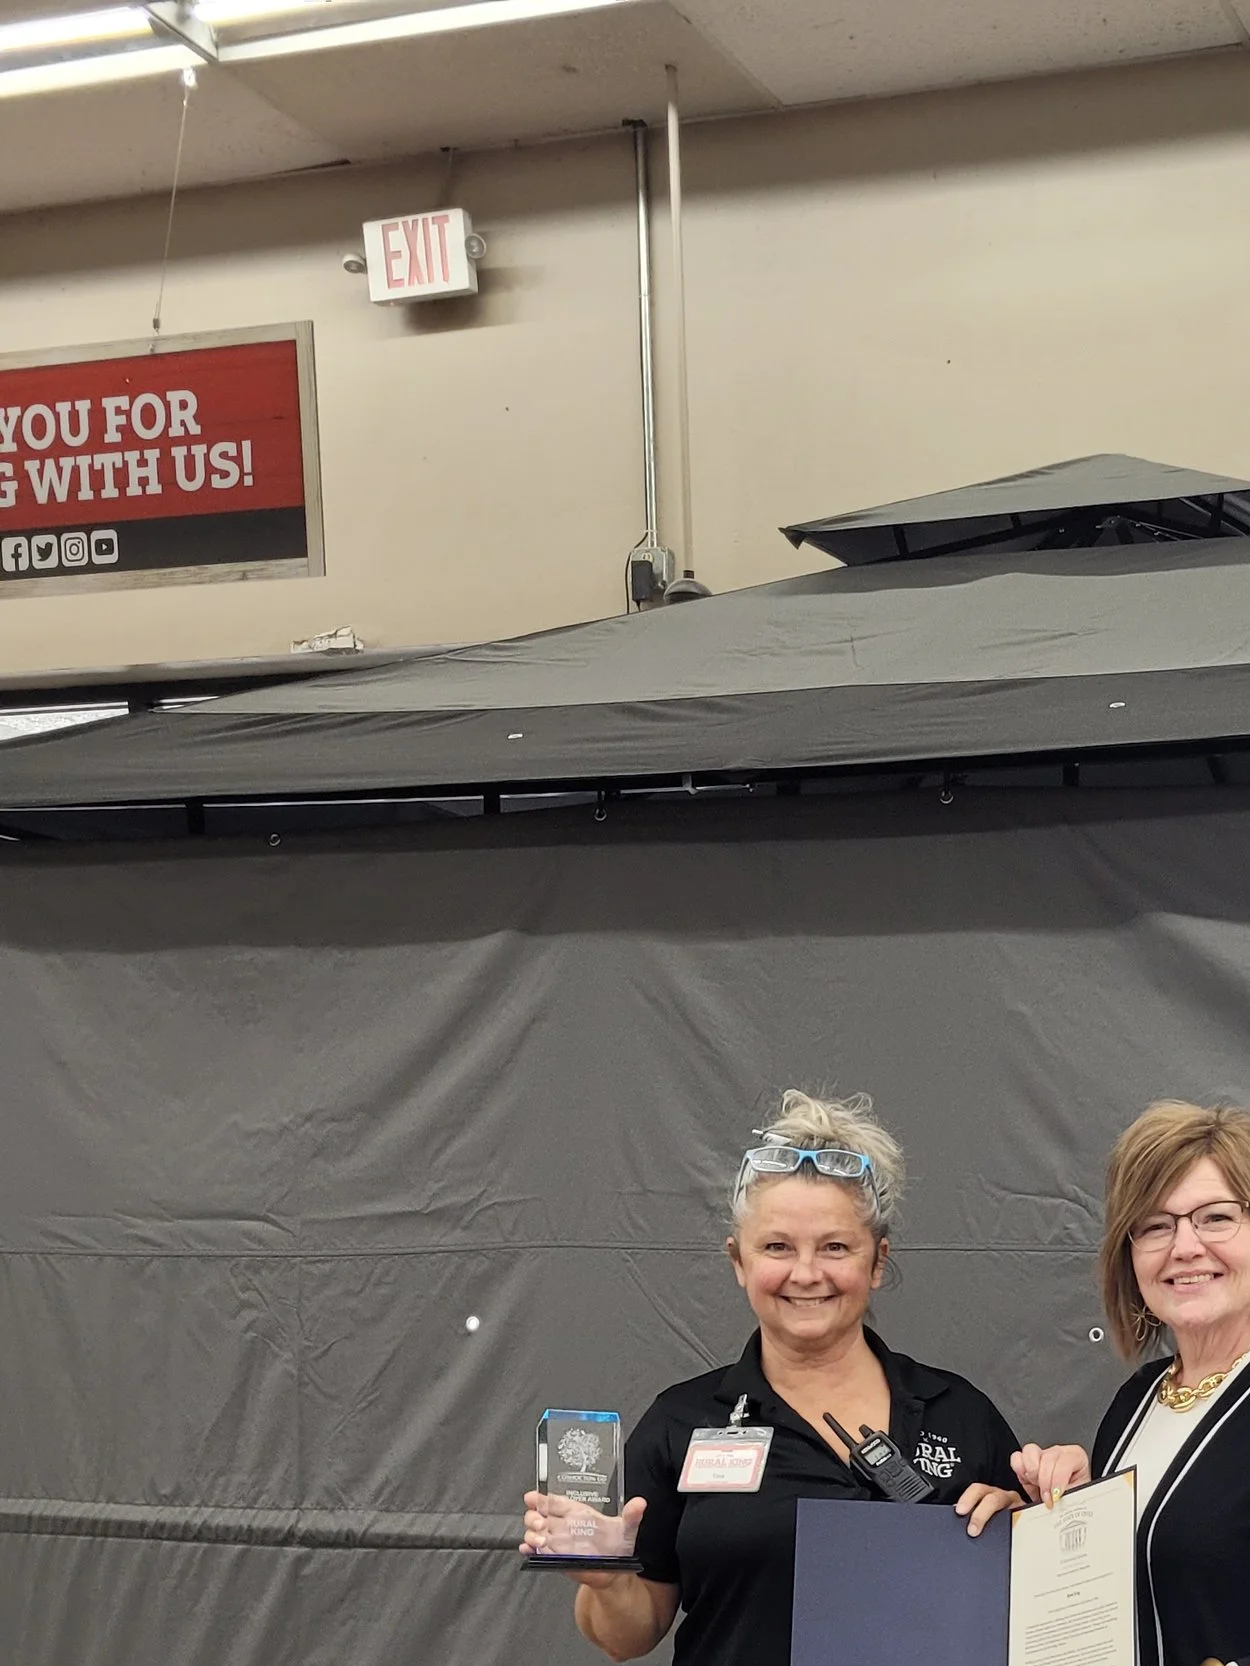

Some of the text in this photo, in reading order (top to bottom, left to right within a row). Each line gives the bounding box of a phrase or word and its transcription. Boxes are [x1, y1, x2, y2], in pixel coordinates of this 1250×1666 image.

[381, 214, 450, 289] EXIT
[0, 389, 201, 453] YOU FOR
[24, 448, 162, 504] WITH
[171, 440, 254, 492] US!
[915, 1443, 961, 1463] RAL
[566, 1519, 598, 1529] RURAL
[570, 1527, 594, 1537] KING
